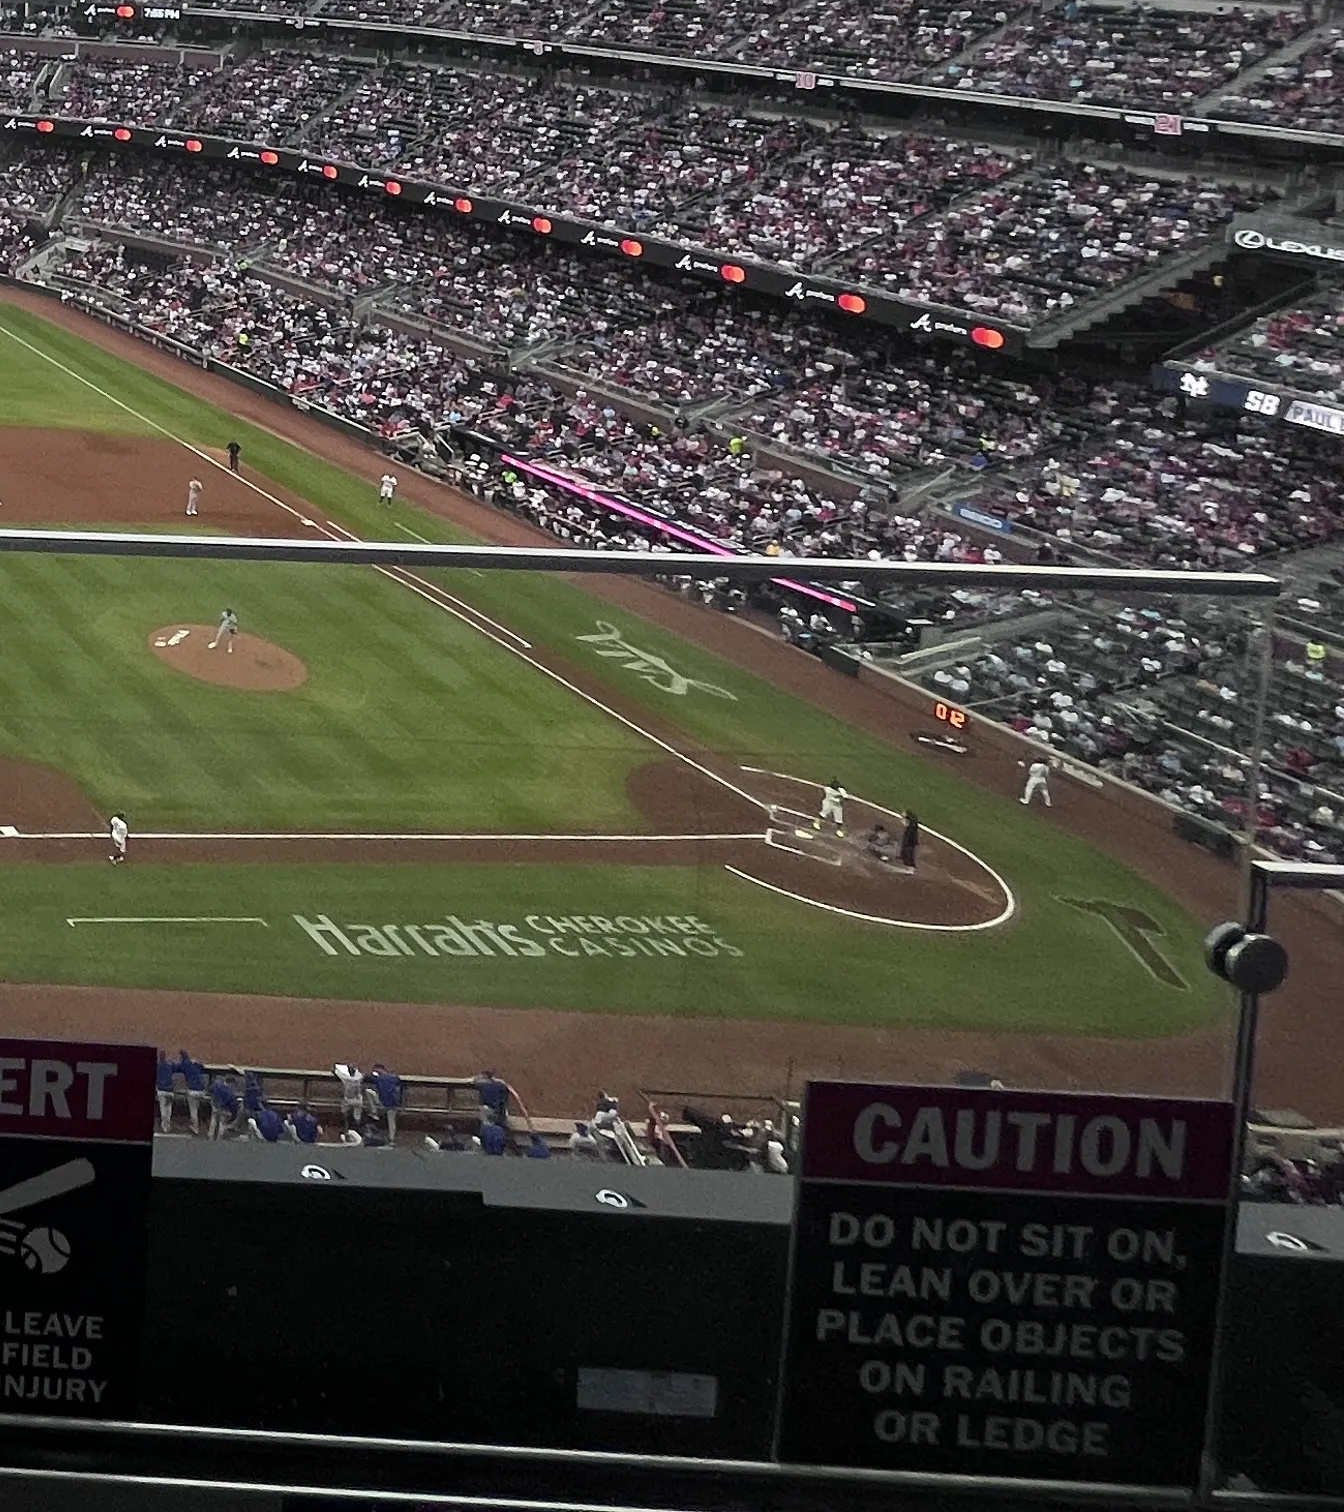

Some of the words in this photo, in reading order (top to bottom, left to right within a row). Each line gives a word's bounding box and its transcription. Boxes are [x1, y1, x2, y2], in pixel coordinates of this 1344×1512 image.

[1243, 390, 1281, 416] 58
[1292, 405, 1337, 429] PAUL
[524, 914, 718, 937] CHEROKEE
[547, 936, 747, 958] CASINOS
[853, 1102, 1187, 1180] CAUTION
[829, 1211, 895, 1248] DO
[911, 1216, 1008, 1254] NOT
[1019, 1222, 1094, 1260] SIT
[1107, 1228, 1189, 1270] ON,
[832, 1264, 952, 1302] LEAN
[968, 1270, 1095, 1308] OVER
[1111, 1277, 1176, 1314] OR
[5, 1310, 105, 1339] LEAVE
[817, 1309, 966, 1351] PLACE
[979, 1317, 1186, 1363] OBJECTS
[2, 1343, 93, 1371] FIELD
[859, 1360, 926, 1396] ON
[942, 1365, 1132, 1409] RAILING
[873, 1411, 940, 1448] OR
[955, 1418, 1110, 1457] LEDGE
